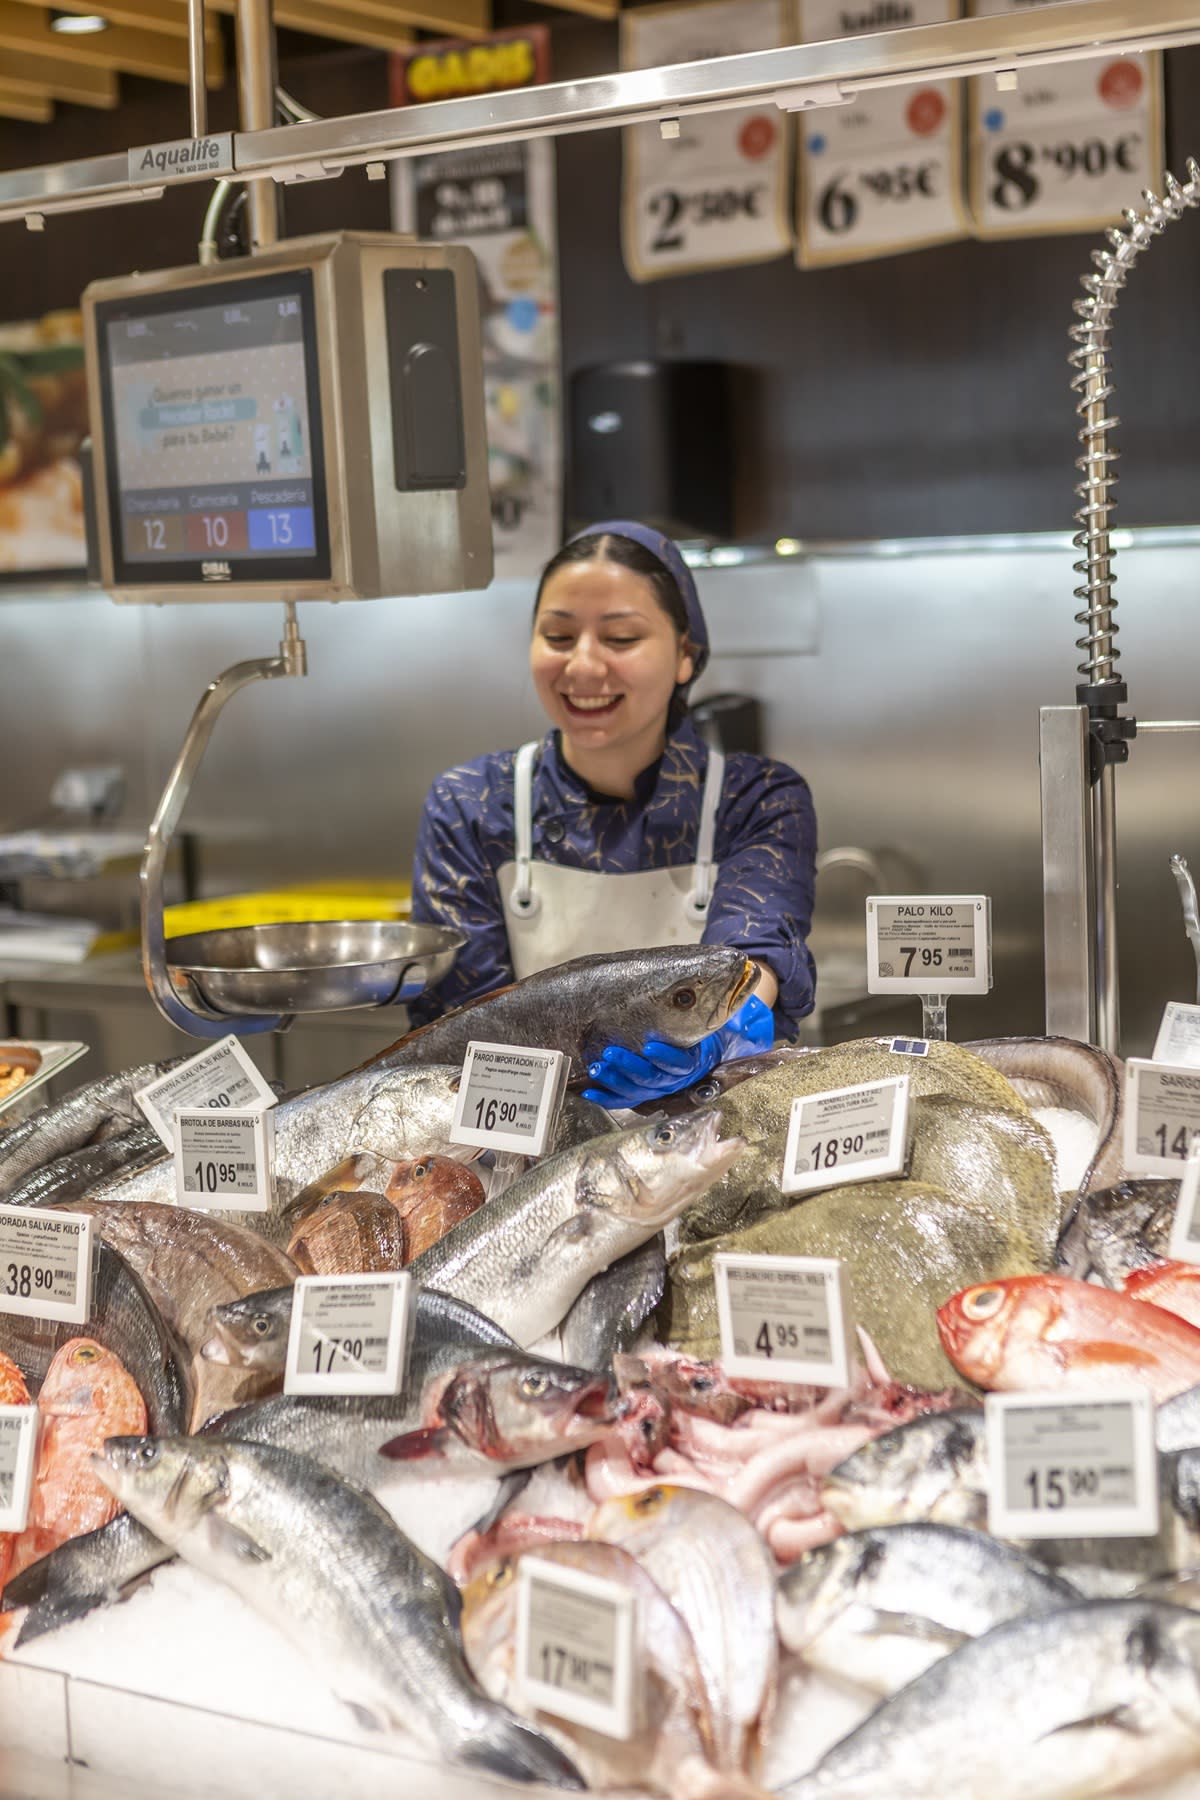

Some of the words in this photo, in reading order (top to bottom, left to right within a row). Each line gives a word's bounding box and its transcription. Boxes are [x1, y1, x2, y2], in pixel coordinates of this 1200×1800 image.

[140, 139, 219, 172] Aqualife
[144, 519, 167, 549] 12
[203, 516, 228, 547] 10
[267, 513, 293, 544] 13
[897, 906, 924, 916] PALO
[929, 906, 953, 916] KILO
[181, 1057, 214, 1083] SALVAJE
[474, 1052, 494, 1063] PARGO
[494, 1055, 534, 1068] IMPORTACION
[181, 1118, 207, 1128] BROTOLA
[208, 1119, 216, 1128] DE
[217, 1119, 241, 1128] BARBAS
[0, 1216, 27, 1229] ORADA
[28, 1220, 61, 1233] SALVAJE
[63, 1223, 80, 1235] KILO
